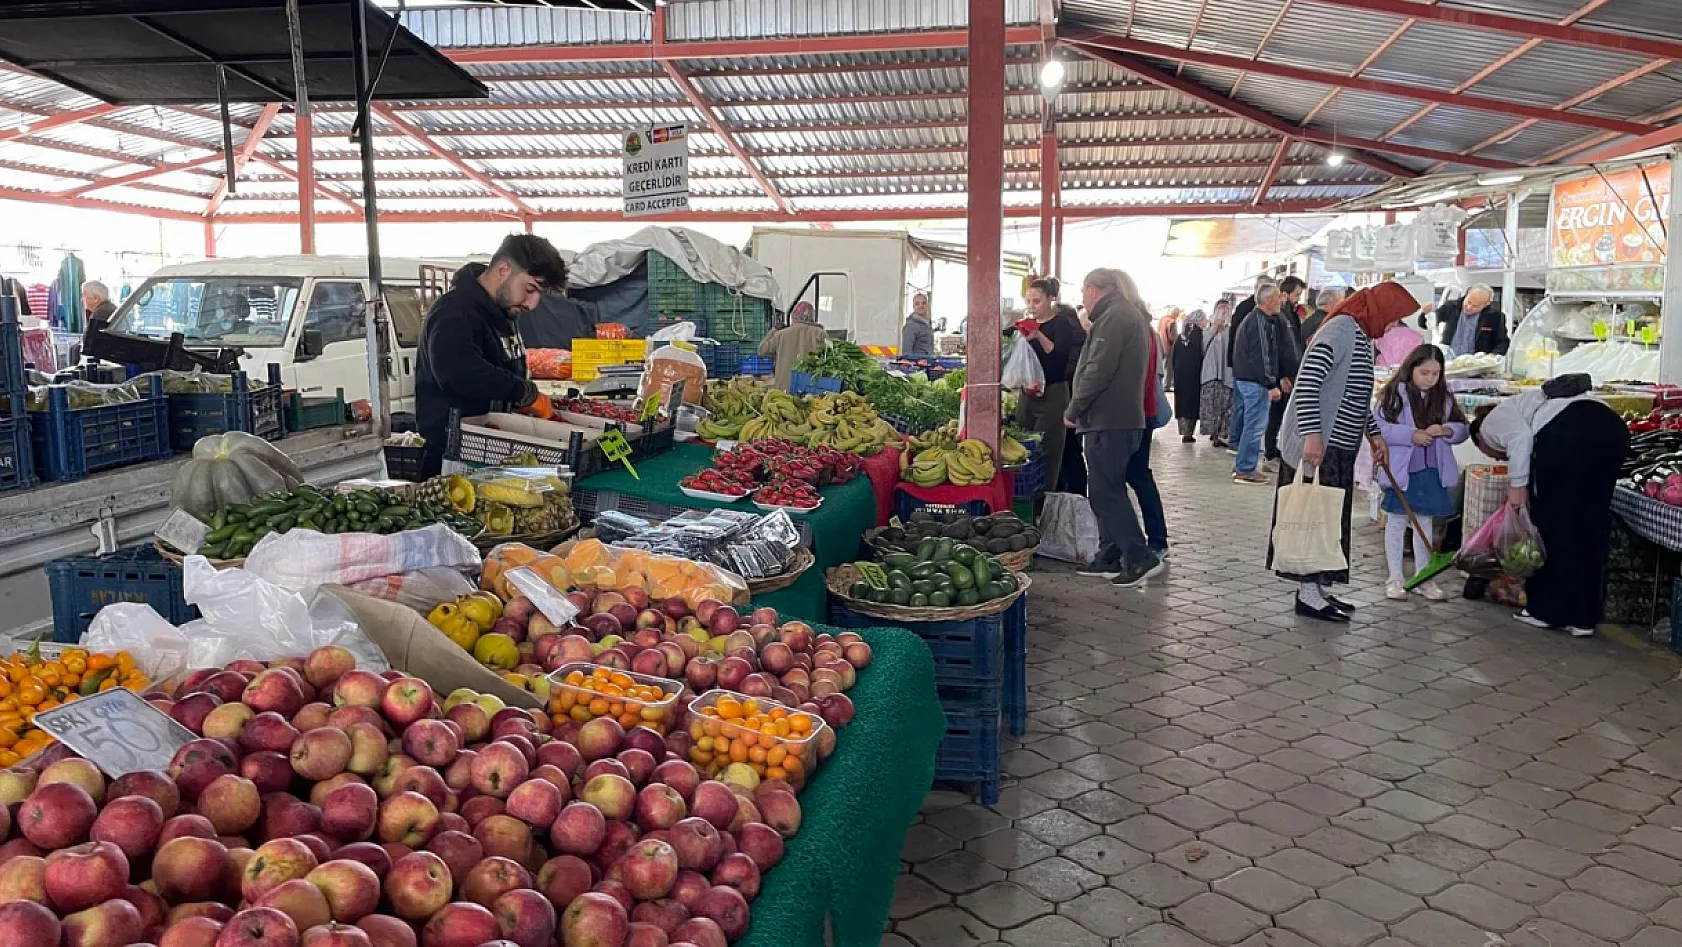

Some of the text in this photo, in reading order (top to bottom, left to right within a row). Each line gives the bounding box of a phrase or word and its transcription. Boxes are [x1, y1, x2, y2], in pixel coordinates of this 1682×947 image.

[627, 156, 683, 174] KREDİ KARTI
[629, 174, 682, 193] GEÇERLİDİR
[625, 196, 686, 213] CARD ACCEPTED
[1558, 196, 1629, 230] ERGİN
[79, 717, 160, 770] 50
